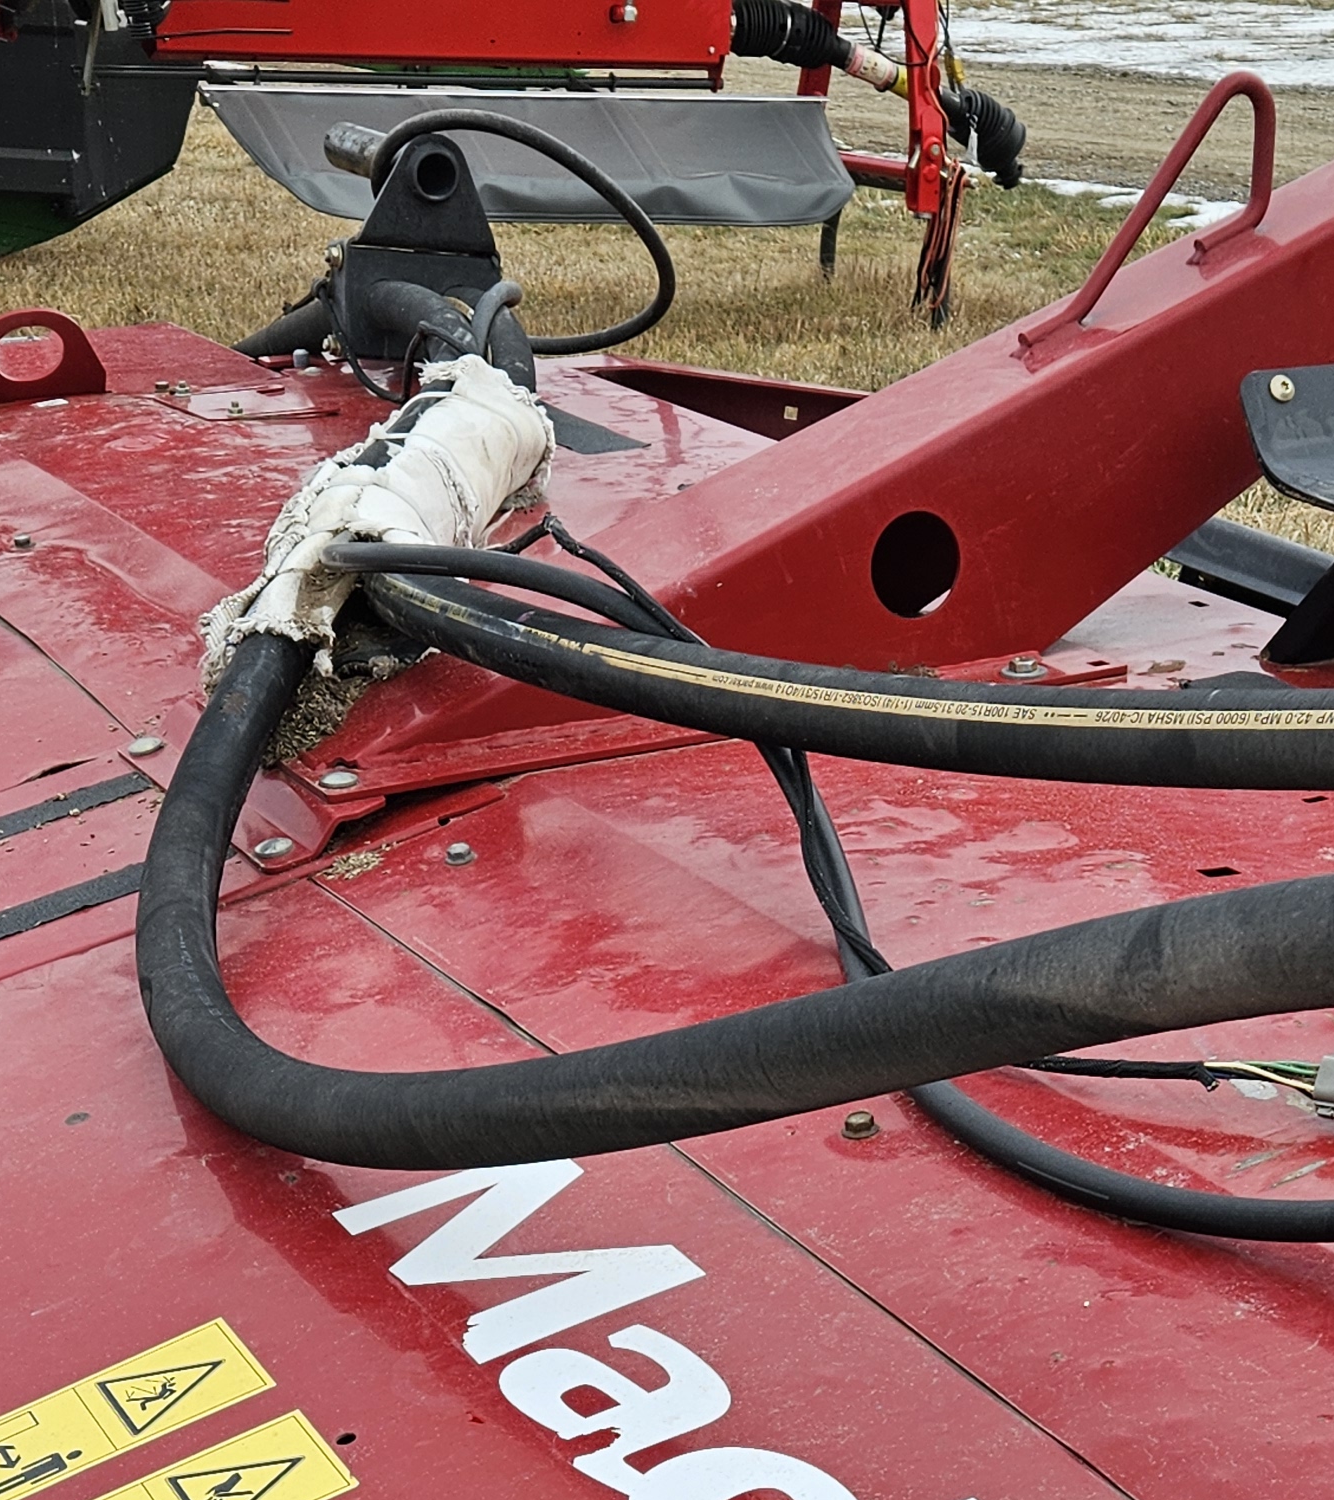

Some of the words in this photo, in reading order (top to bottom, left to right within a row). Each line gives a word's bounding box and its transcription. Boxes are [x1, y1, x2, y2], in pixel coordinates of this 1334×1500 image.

[914, 701, 955, 714] 31.5mm
[955, 704, 1010, 718] 100R15-20
[1012, 707, 1038, 720] SAE
[1094, 710, 1143, 724] IC-40/26
[1148, 711, 1185, 725] MSHA
[1216, 712, 1251, 726] (6000
[1253, 712, 1283, 725] MPa
[1284, 712, 1314, 725] 42.0
